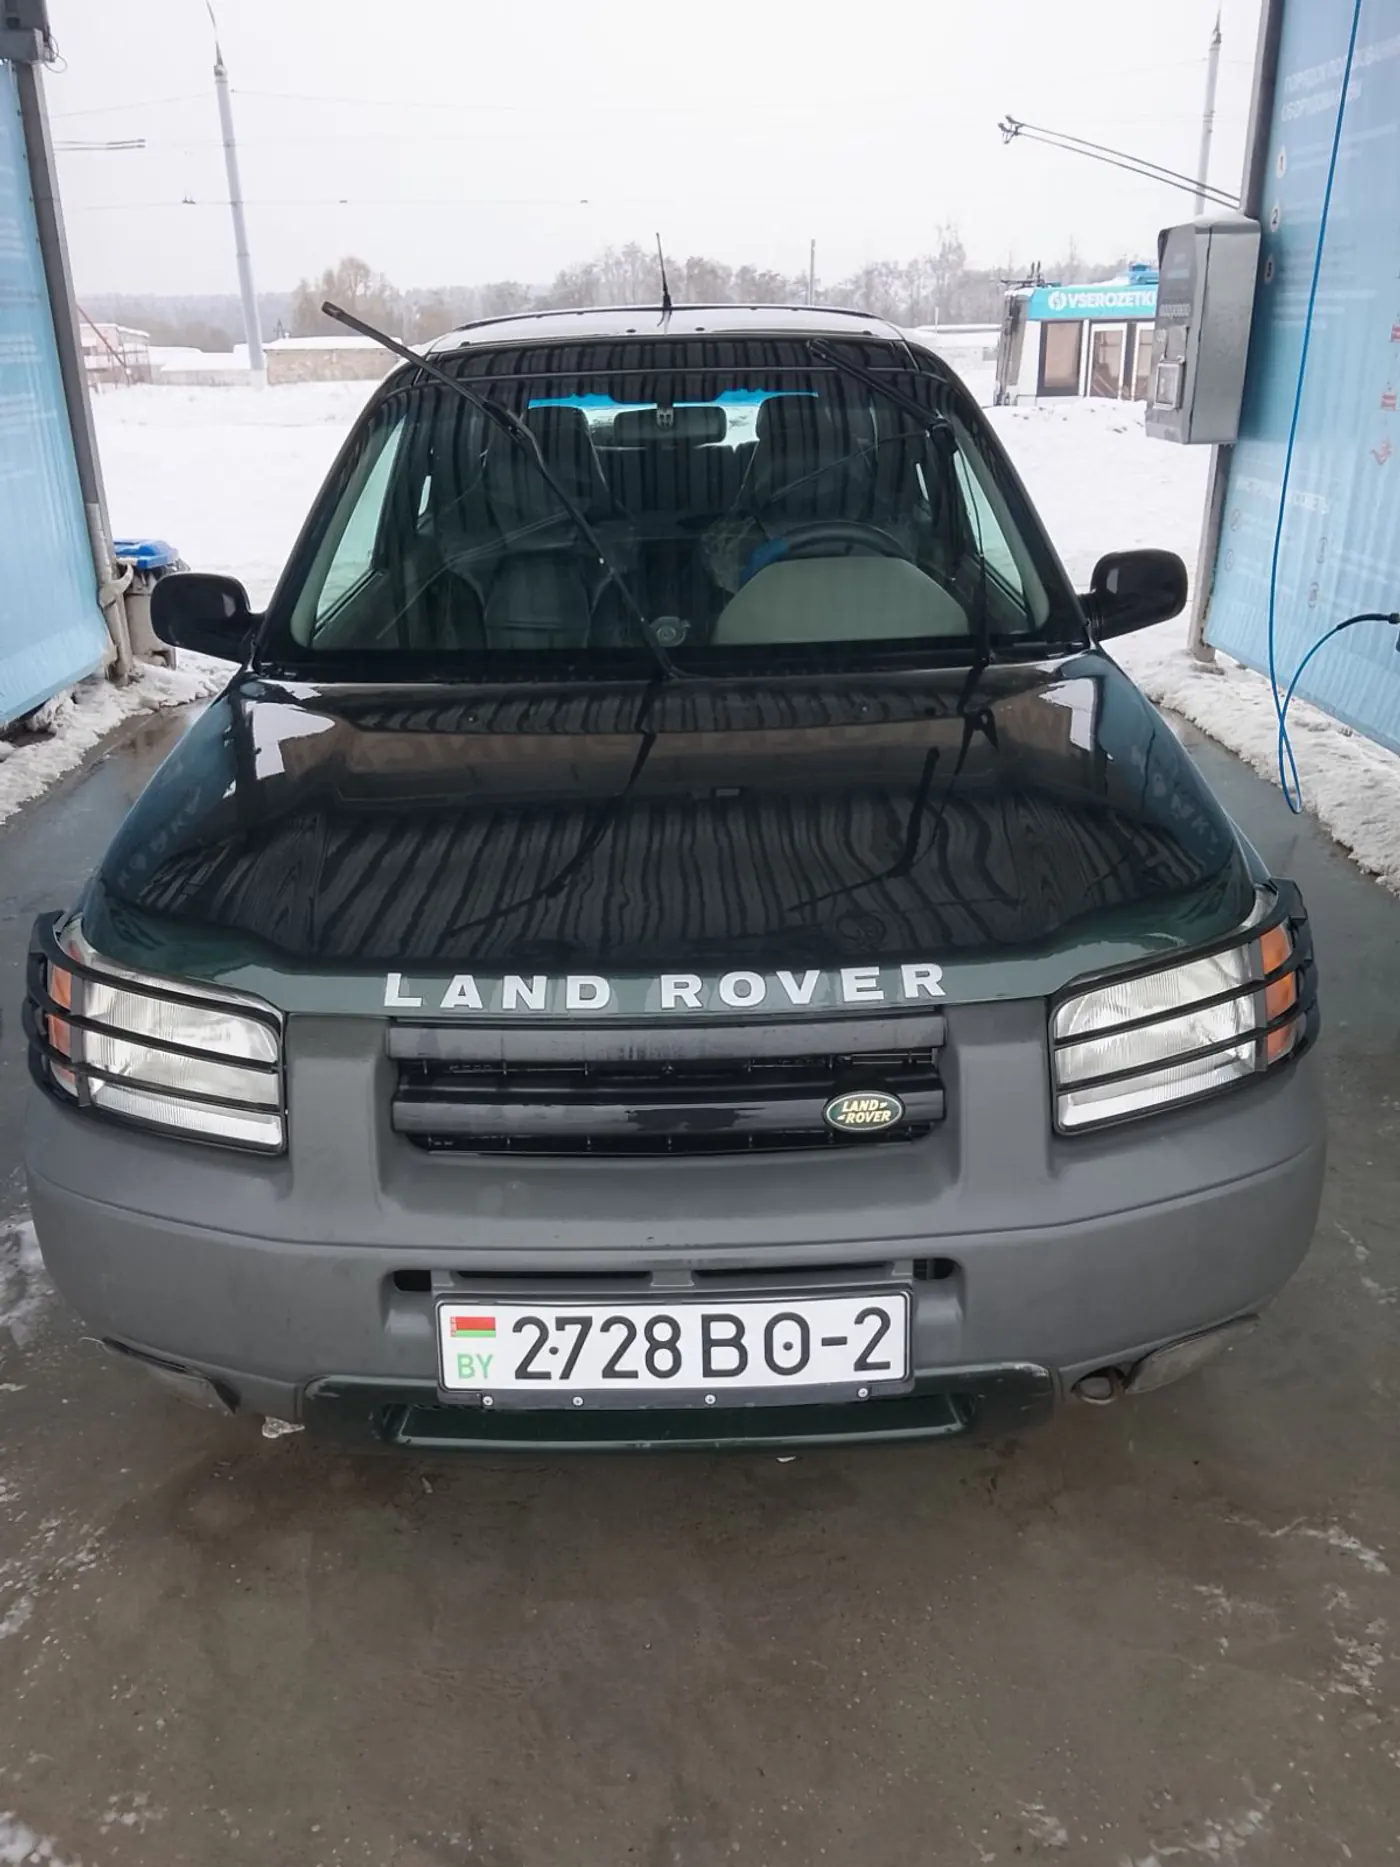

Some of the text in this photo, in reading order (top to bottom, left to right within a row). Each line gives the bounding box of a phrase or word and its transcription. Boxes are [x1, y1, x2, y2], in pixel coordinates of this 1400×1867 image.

[384, 963, 946, 1010] LAND ROVER
[842, 1099, 879, 1112] LAND
[845, 1110, 892, 1124] ROVER
[457, 1353, 493, 1380] BY
